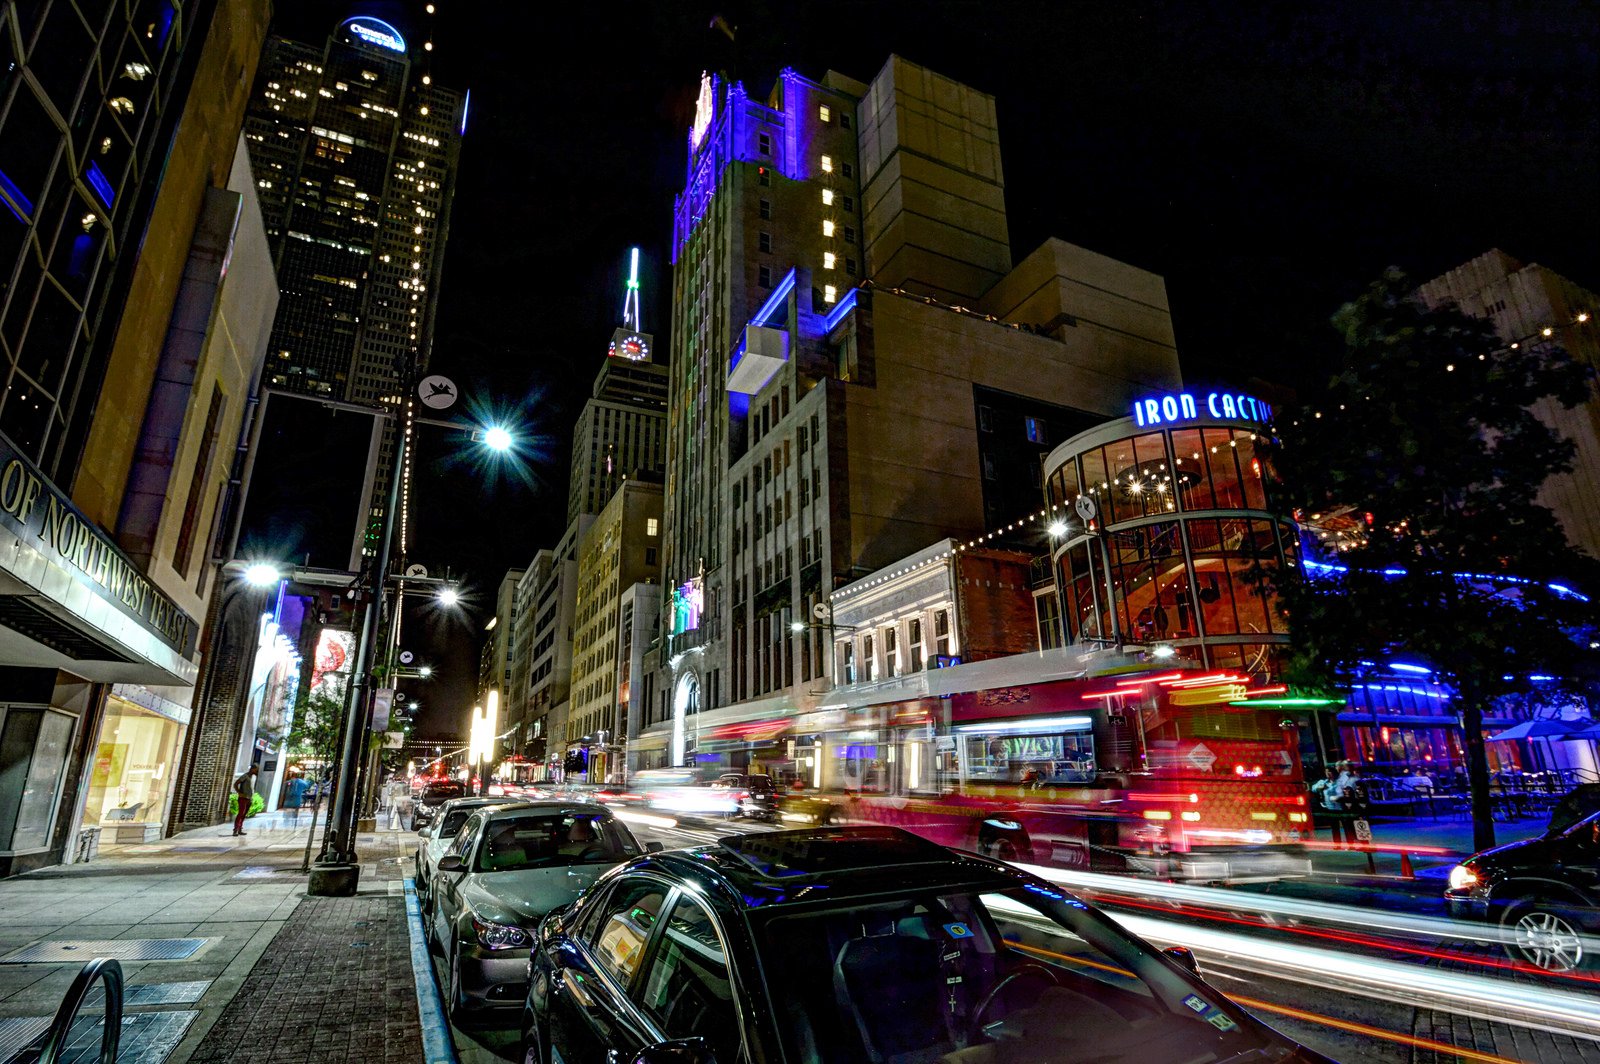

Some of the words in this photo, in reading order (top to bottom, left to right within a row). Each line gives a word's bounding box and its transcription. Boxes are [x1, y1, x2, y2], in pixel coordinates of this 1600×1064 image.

[1134, 394, 1197, 427] IRON
[1, 460, 41, 526] OF
[39, 493, 150, 617] NORTHWEST
[149, 590, 183, 643] TEXAS
